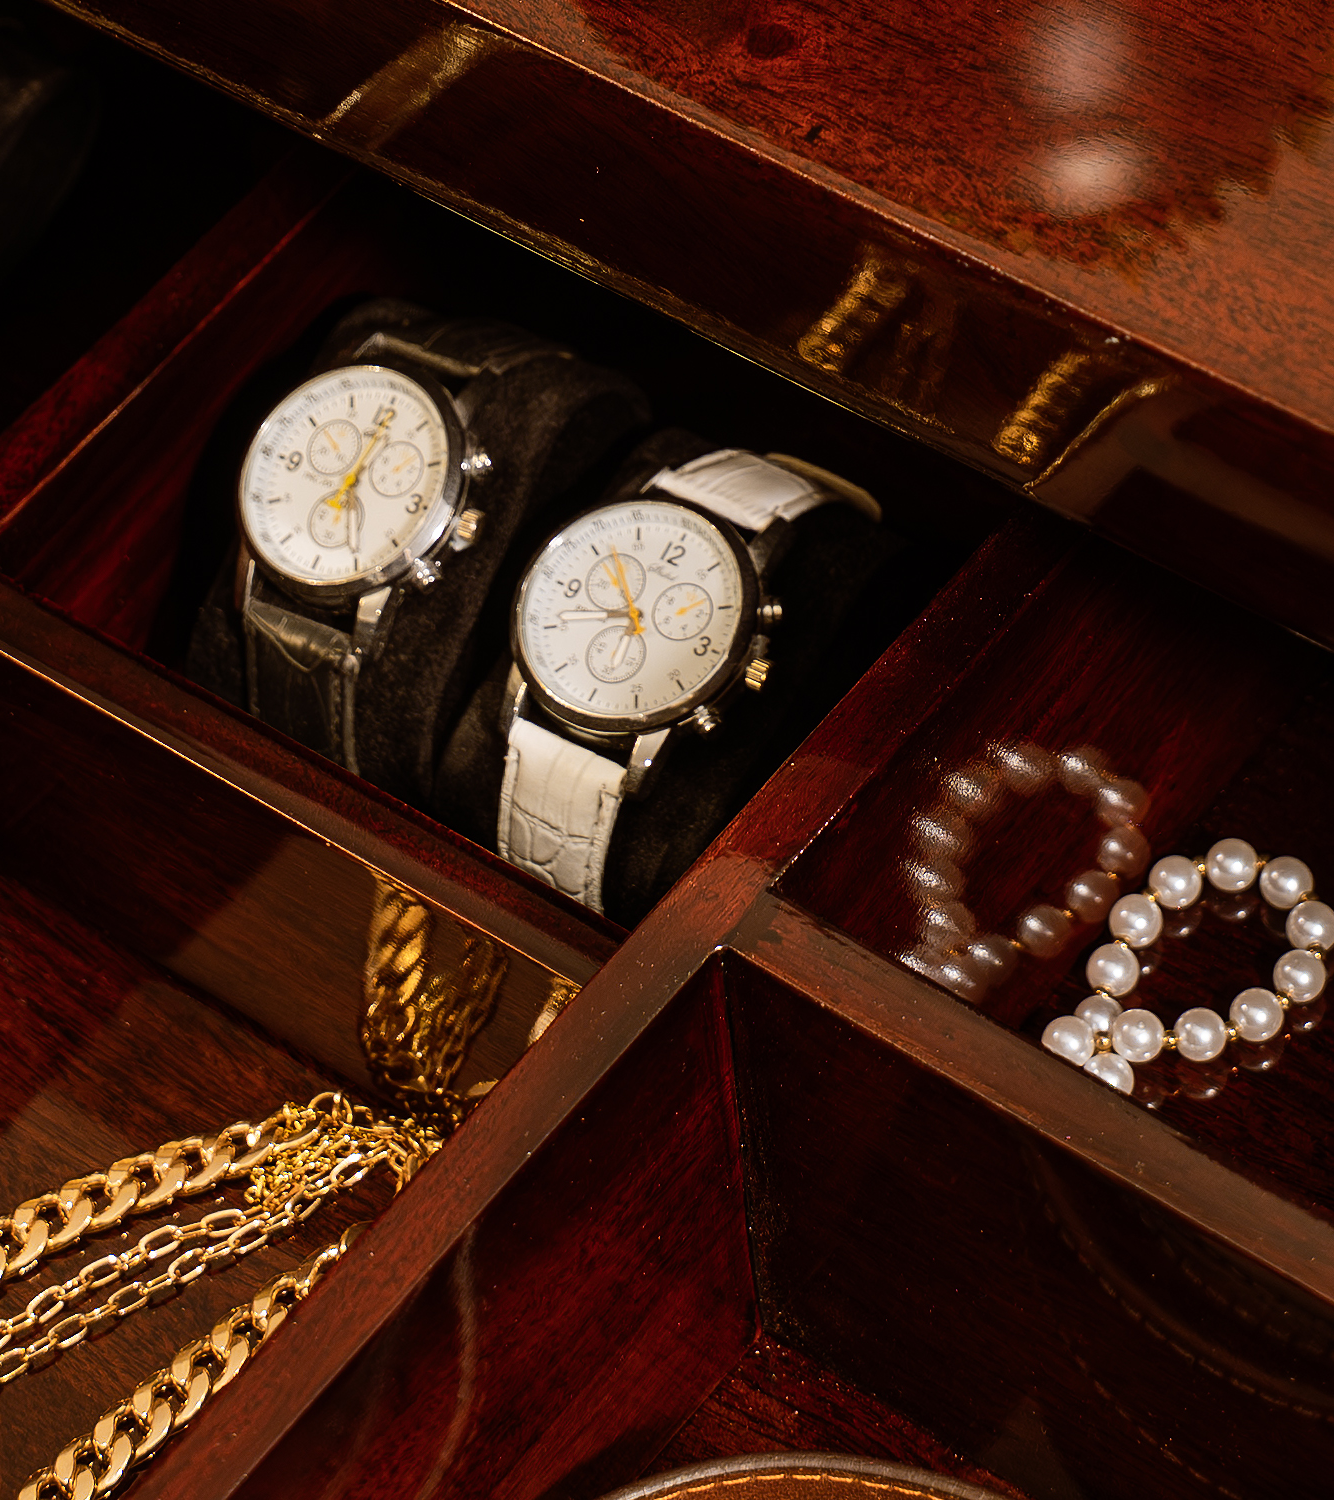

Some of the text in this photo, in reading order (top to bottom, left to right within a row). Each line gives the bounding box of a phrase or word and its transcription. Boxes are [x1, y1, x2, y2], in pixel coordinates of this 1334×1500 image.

[287, 450, 303, 472] 9
[405, 493, 423, 515] 3
[660, 541, 686, 567] 12
[564, 578, 582, 598] 9
[693, 635, 712, 657] 3
